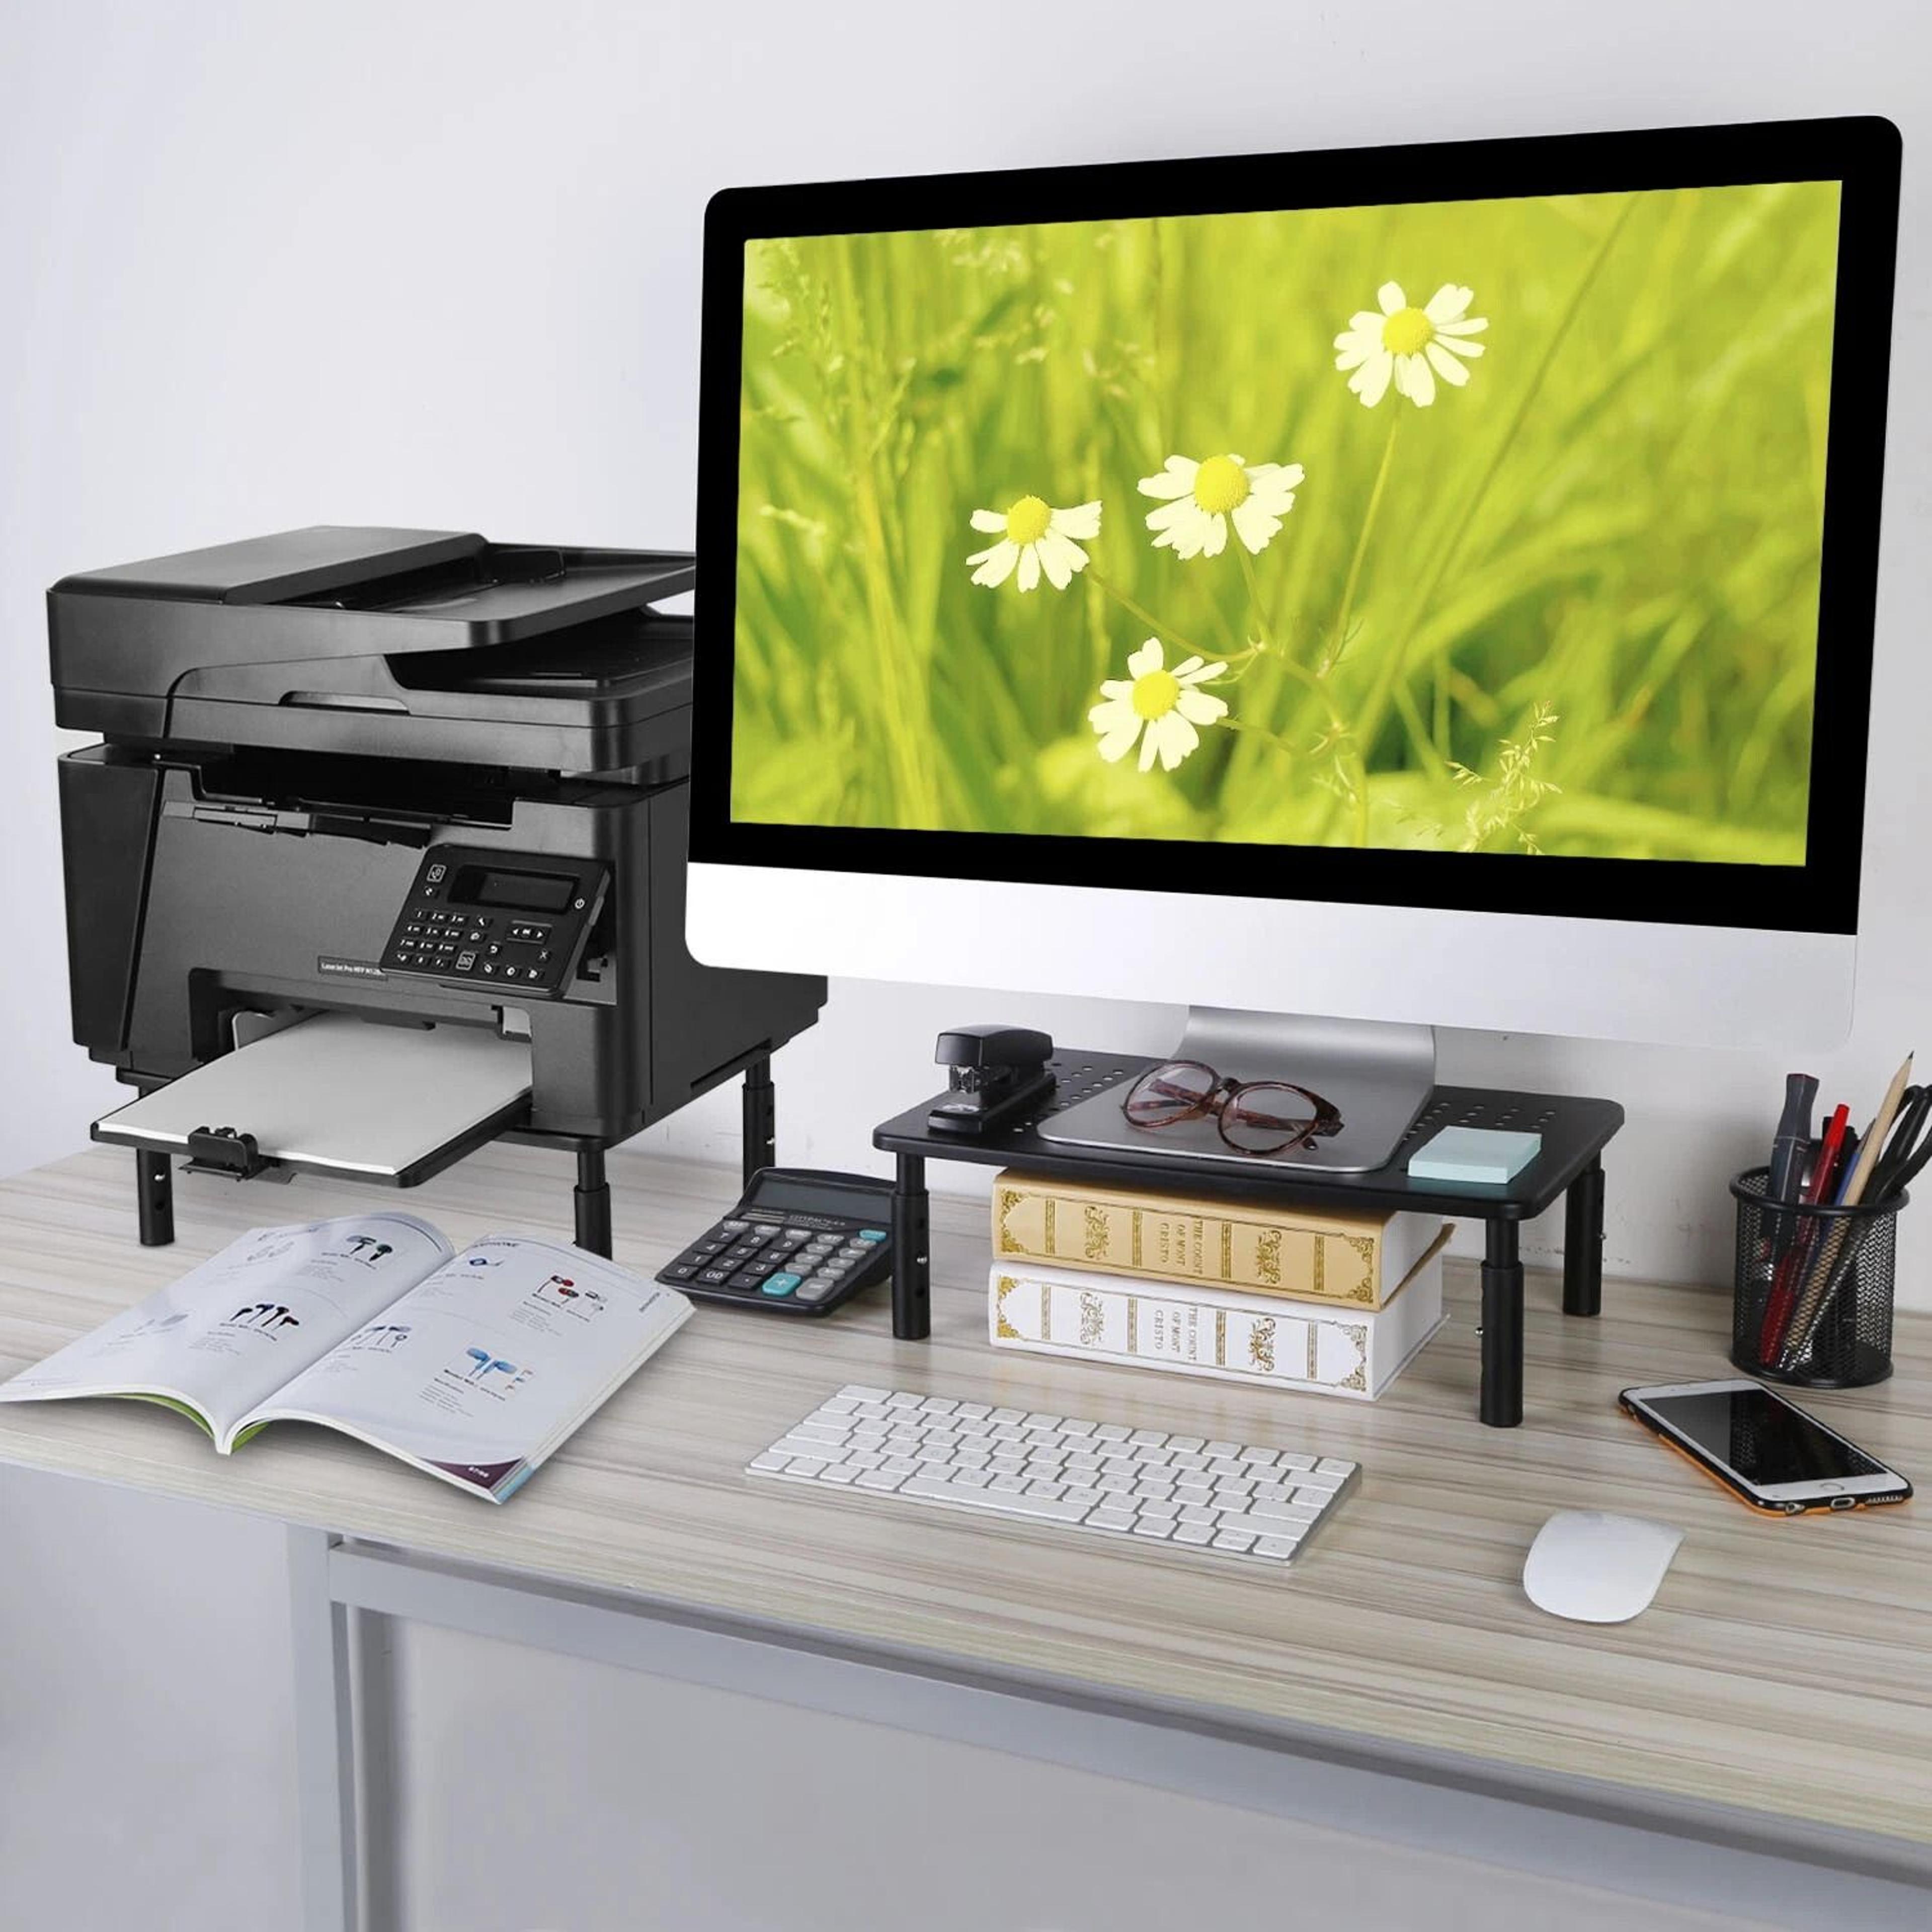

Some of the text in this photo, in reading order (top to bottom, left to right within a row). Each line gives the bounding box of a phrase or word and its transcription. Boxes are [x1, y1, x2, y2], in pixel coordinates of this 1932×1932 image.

[1160, 1223, 1169, 1263] CRISTO
[1193, 1220, 1203, 1275] THE COUNT
[1154, 1309, 1163, 1349] CRISTO
[1188, 1307, 1197, 1327] THE
